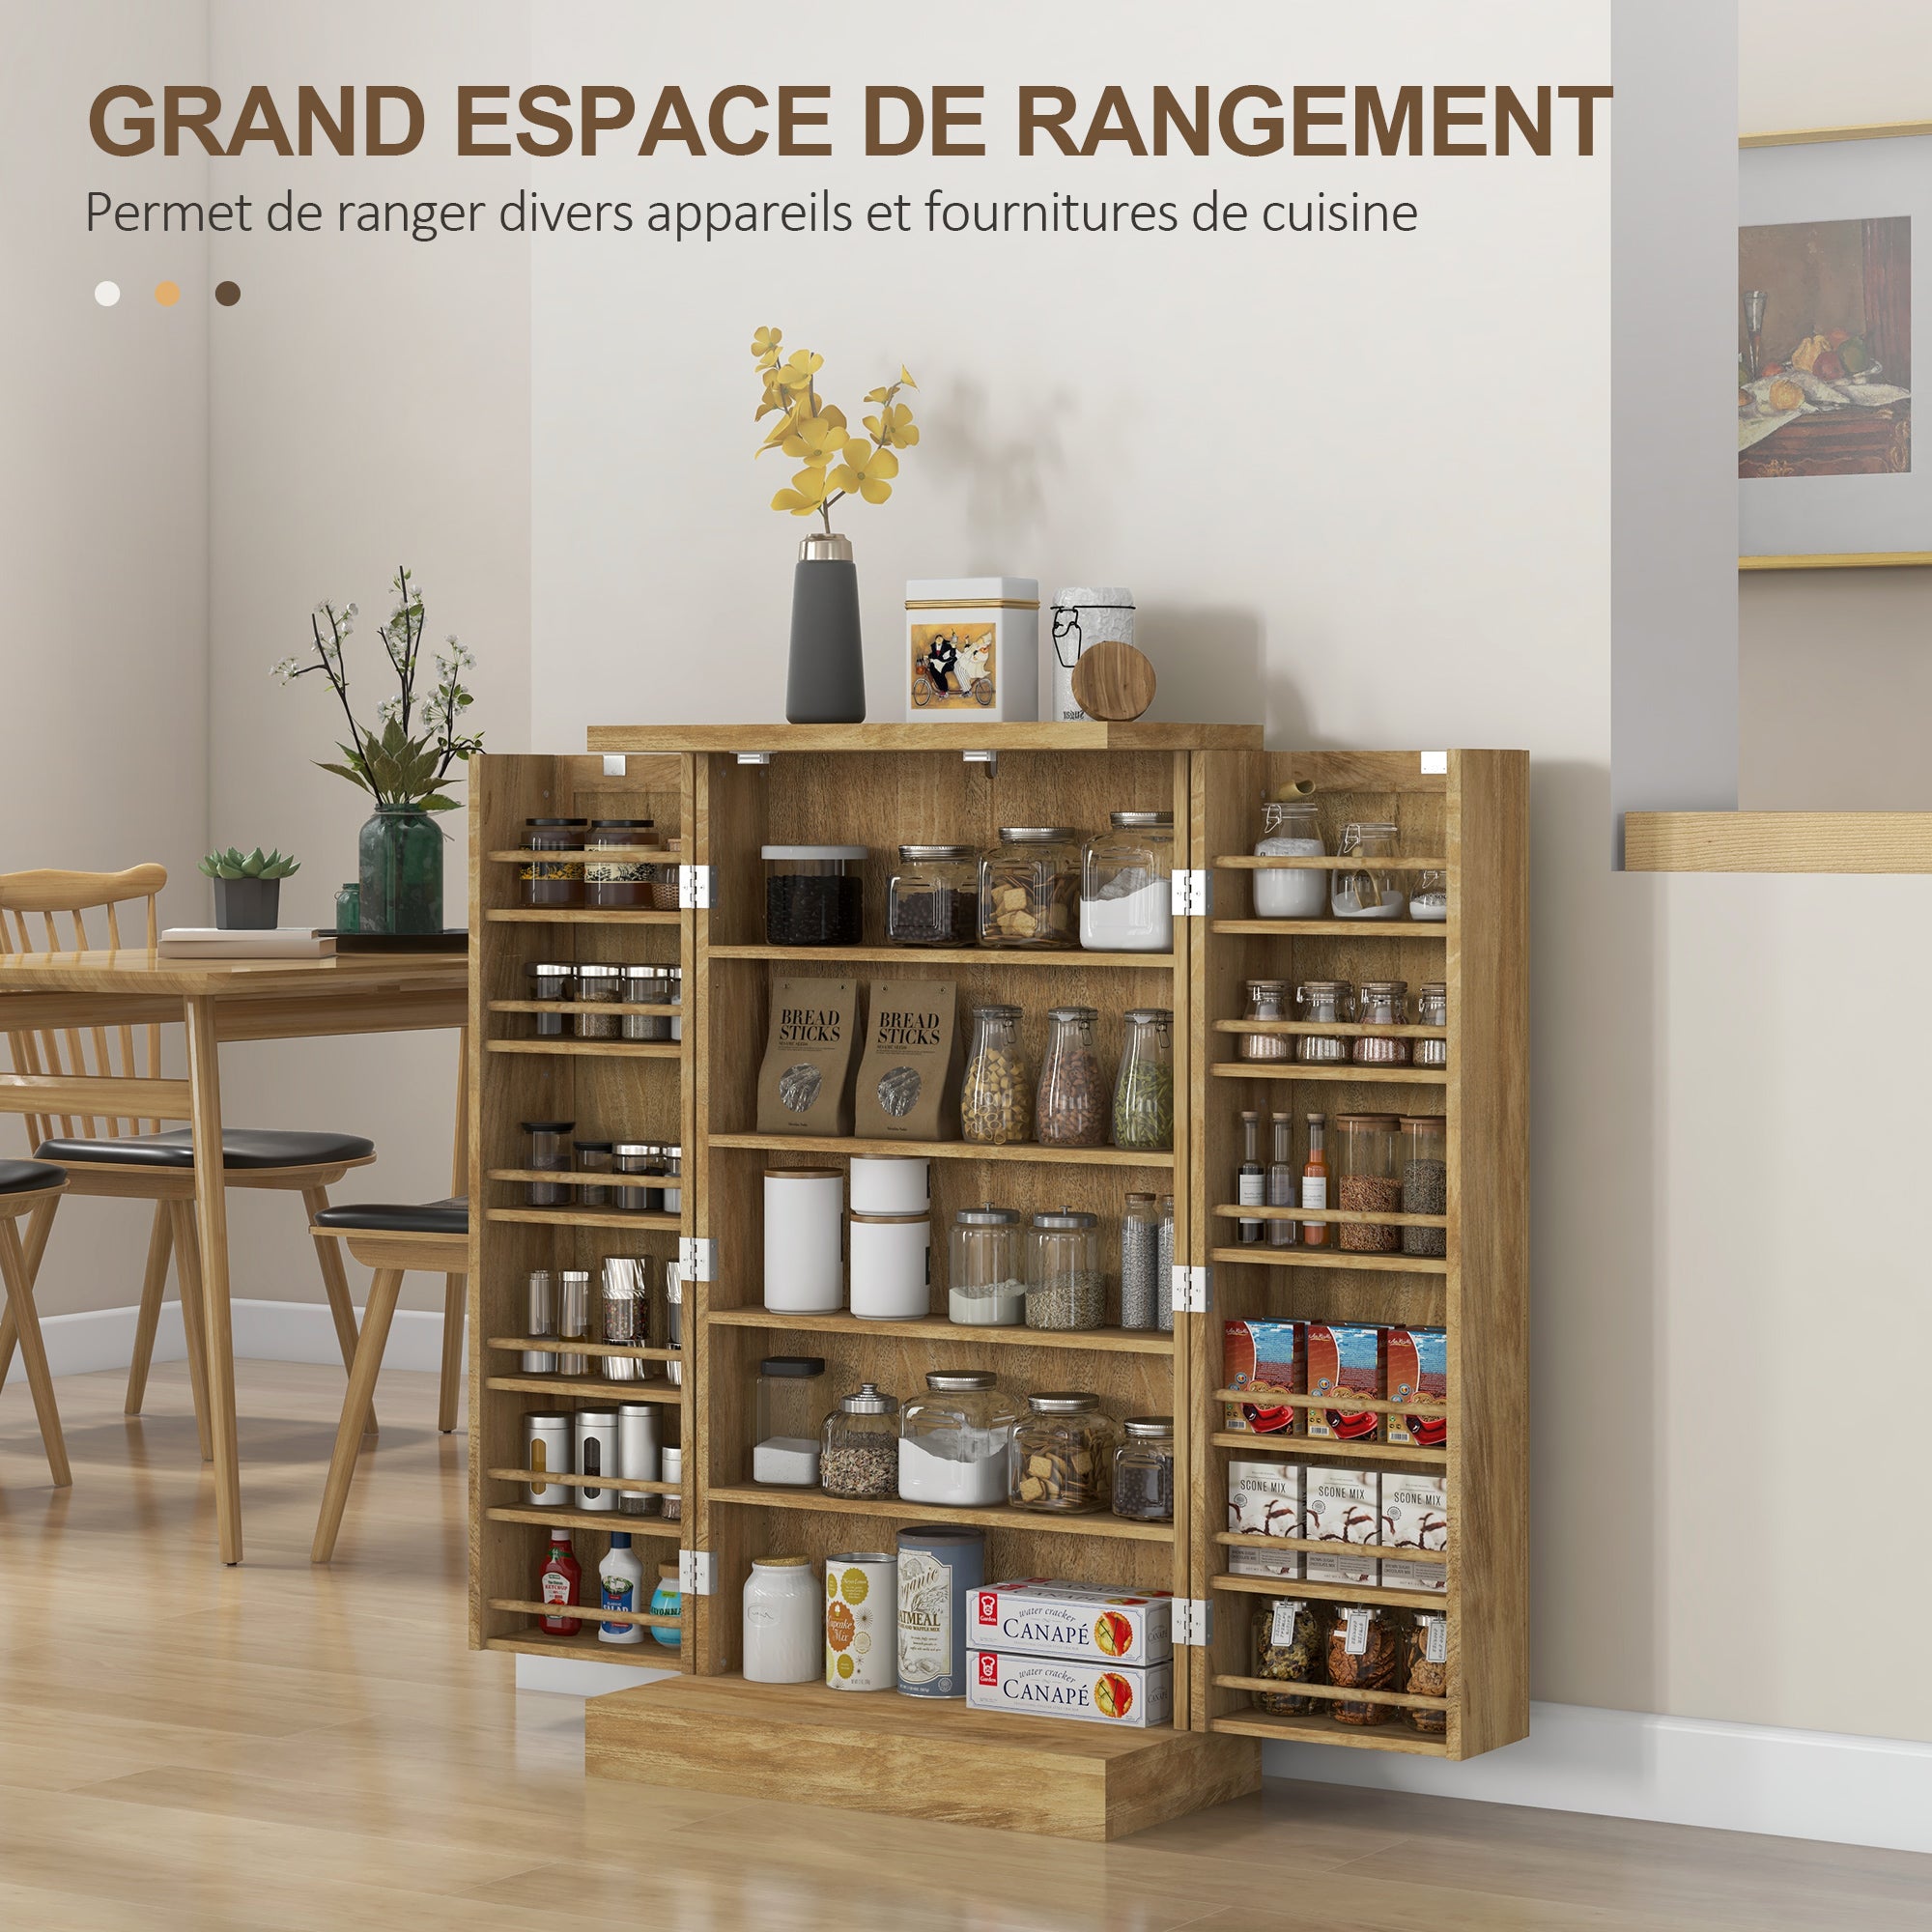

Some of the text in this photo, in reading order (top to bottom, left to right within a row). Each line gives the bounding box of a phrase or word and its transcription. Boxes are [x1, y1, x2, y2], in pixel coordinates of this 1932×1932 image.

[781, 1009, 840, 1025] BREAD
[878, 1012, 940, 1029] BREAD
[780, 1025, 840, 1041] STICKS
[878, 1028, 940, 1045] STICKS
[1240, 1479, 1286, 1493] SCONE MIX
[1319, 1486, 1365, 1499] SCONE MIX
[1394, 1492, 1441, 1506] SCONE MIX
[1018, 1607, 1076, 1623] water cracker
[1003, 1618, 1090, 1645] CANAPÉ
[1018, 1668, 1076, 1684] water cracker
[1003, 1679, 1090, 1706] CANAPÉ
